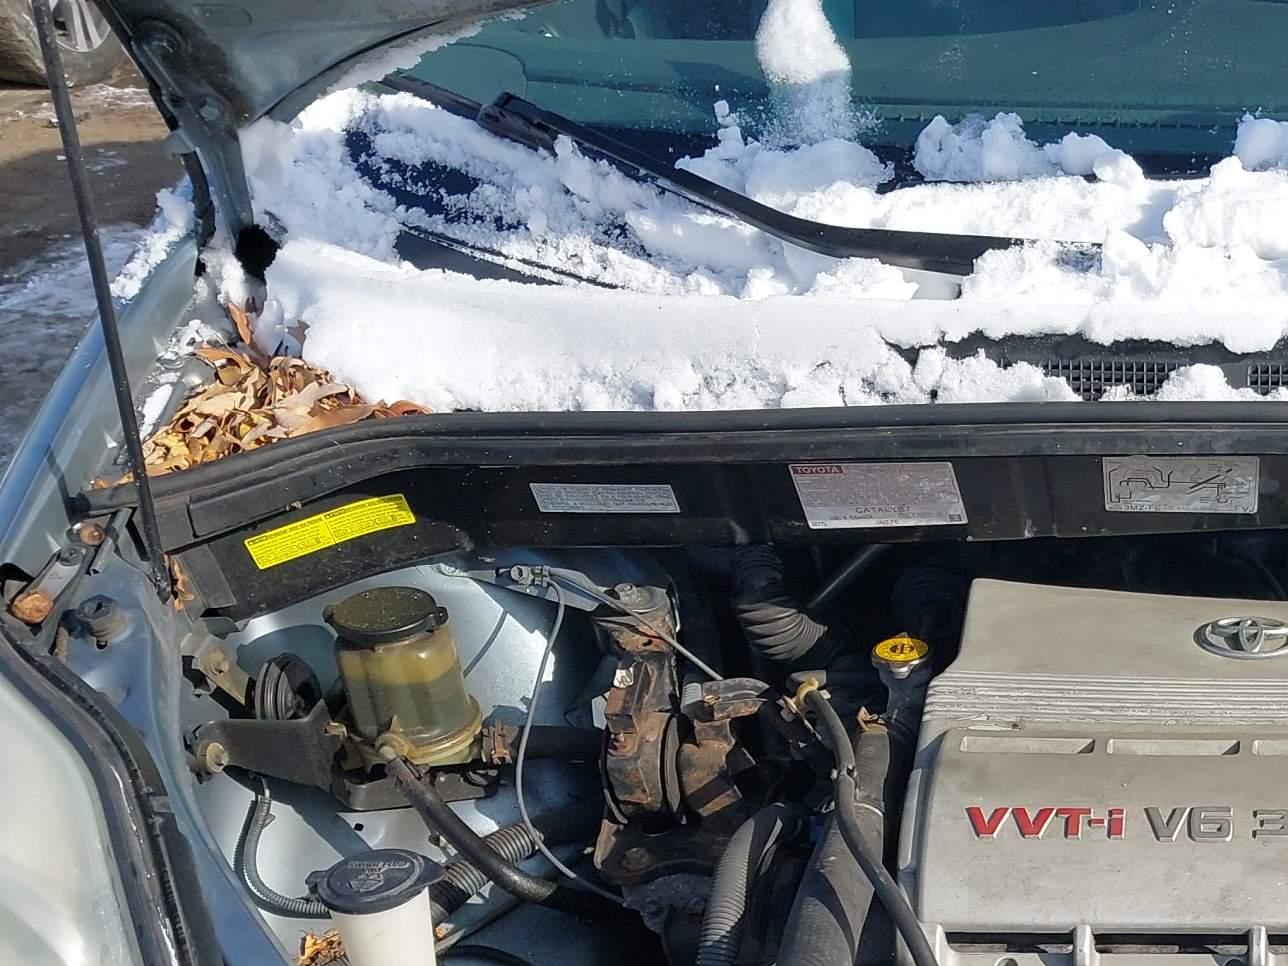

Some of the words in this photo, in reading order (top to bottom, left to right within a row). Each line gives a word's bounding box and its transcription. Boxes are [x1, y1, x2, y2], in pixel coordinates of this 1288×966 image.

[796, 466, 840, 474] TOYOTA
[965, 806, 1126, 841] VVT-i
[1144, 807, 1234, 842] V6
